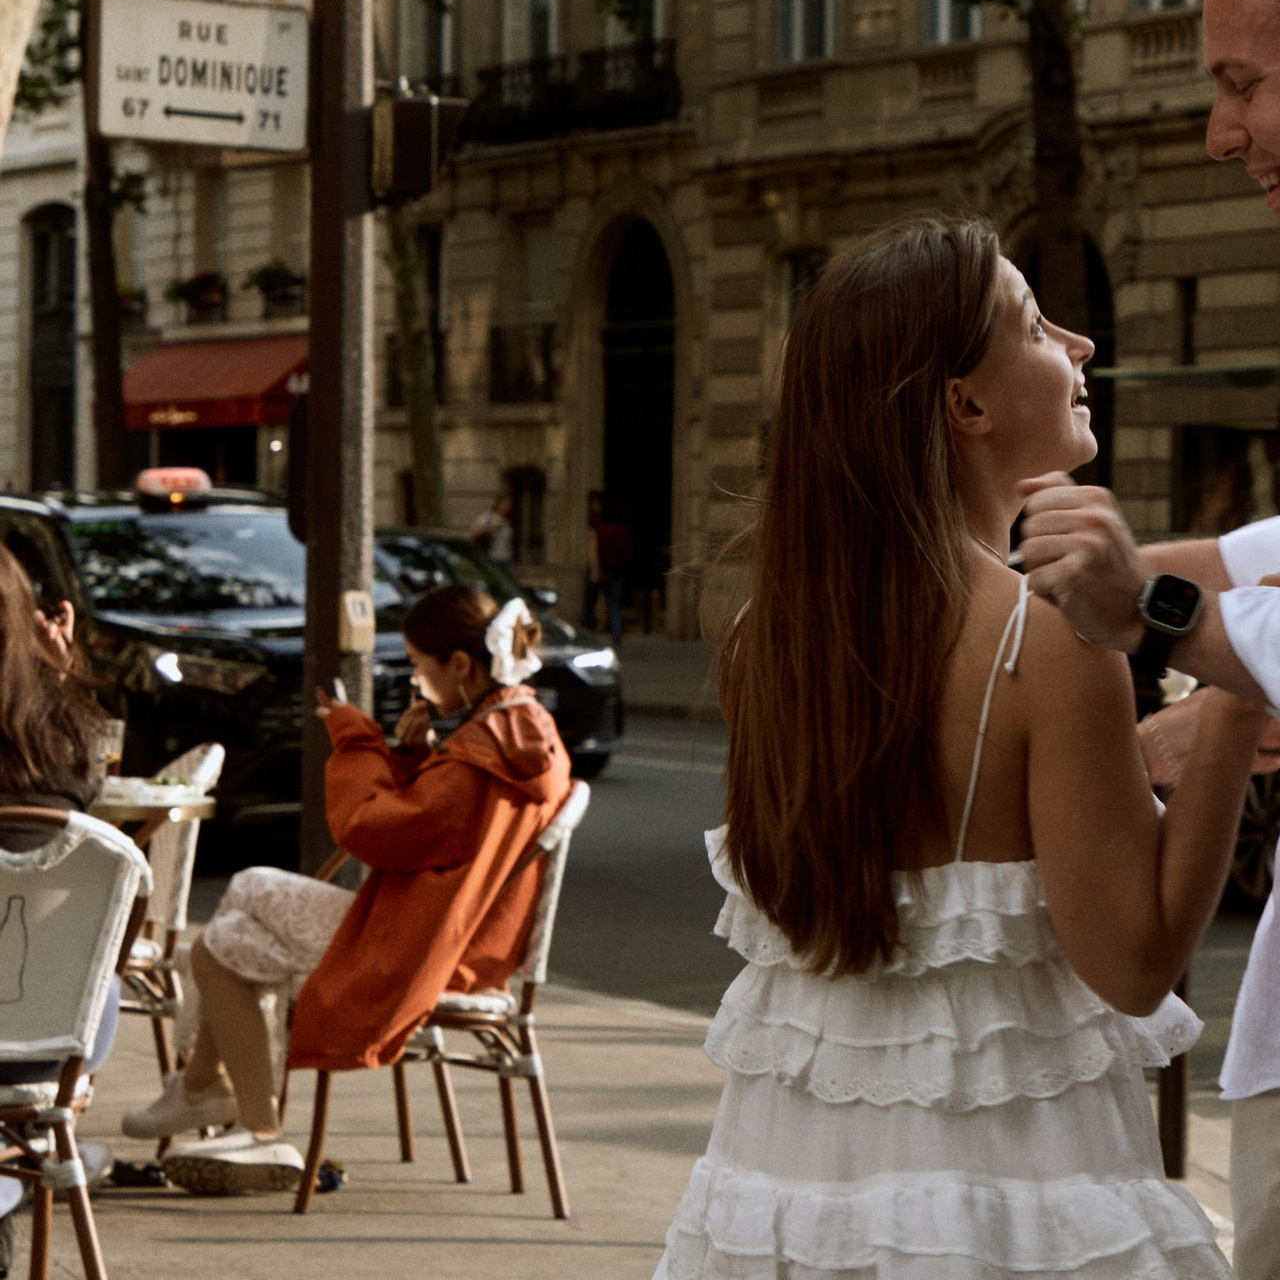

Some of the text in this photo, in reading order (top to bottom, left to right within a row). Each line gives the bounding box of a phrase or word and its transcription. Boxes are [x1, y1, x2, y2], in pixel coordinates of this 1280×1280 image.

[179, 21, 229, 45] RUE
[158, 55, 288, 97] DOMINIQUE
[122, 97, 281, 131] 67 71
